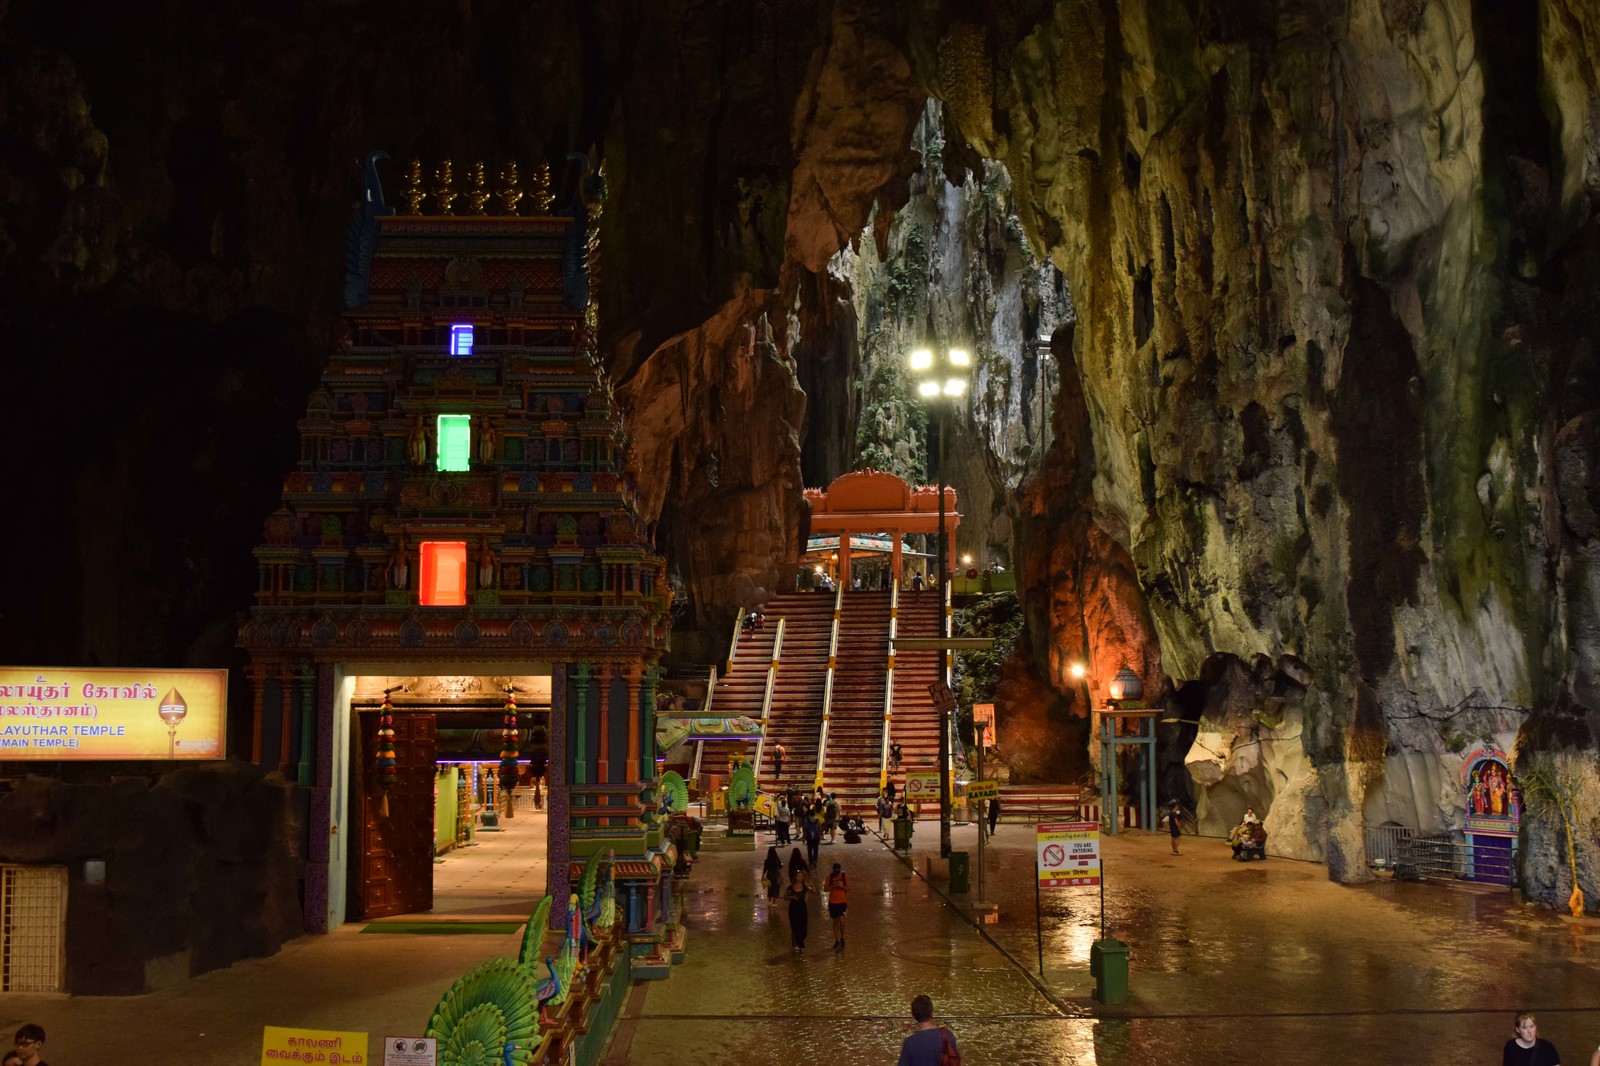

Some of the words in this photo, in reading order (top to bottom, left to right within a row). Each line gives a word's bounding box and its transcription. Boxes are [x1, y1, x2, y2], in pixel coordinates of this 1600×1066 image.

[82, 683, 157, 699] கோவில்
[73, 725, 125, 736] TEMPLE
[33, 738, 79, 749] TEMPLE)
[287, 1037, 342, 1048] காலணி
[265, 1048, 325, 1062] வைக்கும்
[329, 1052, 363, 1064] இடம்
